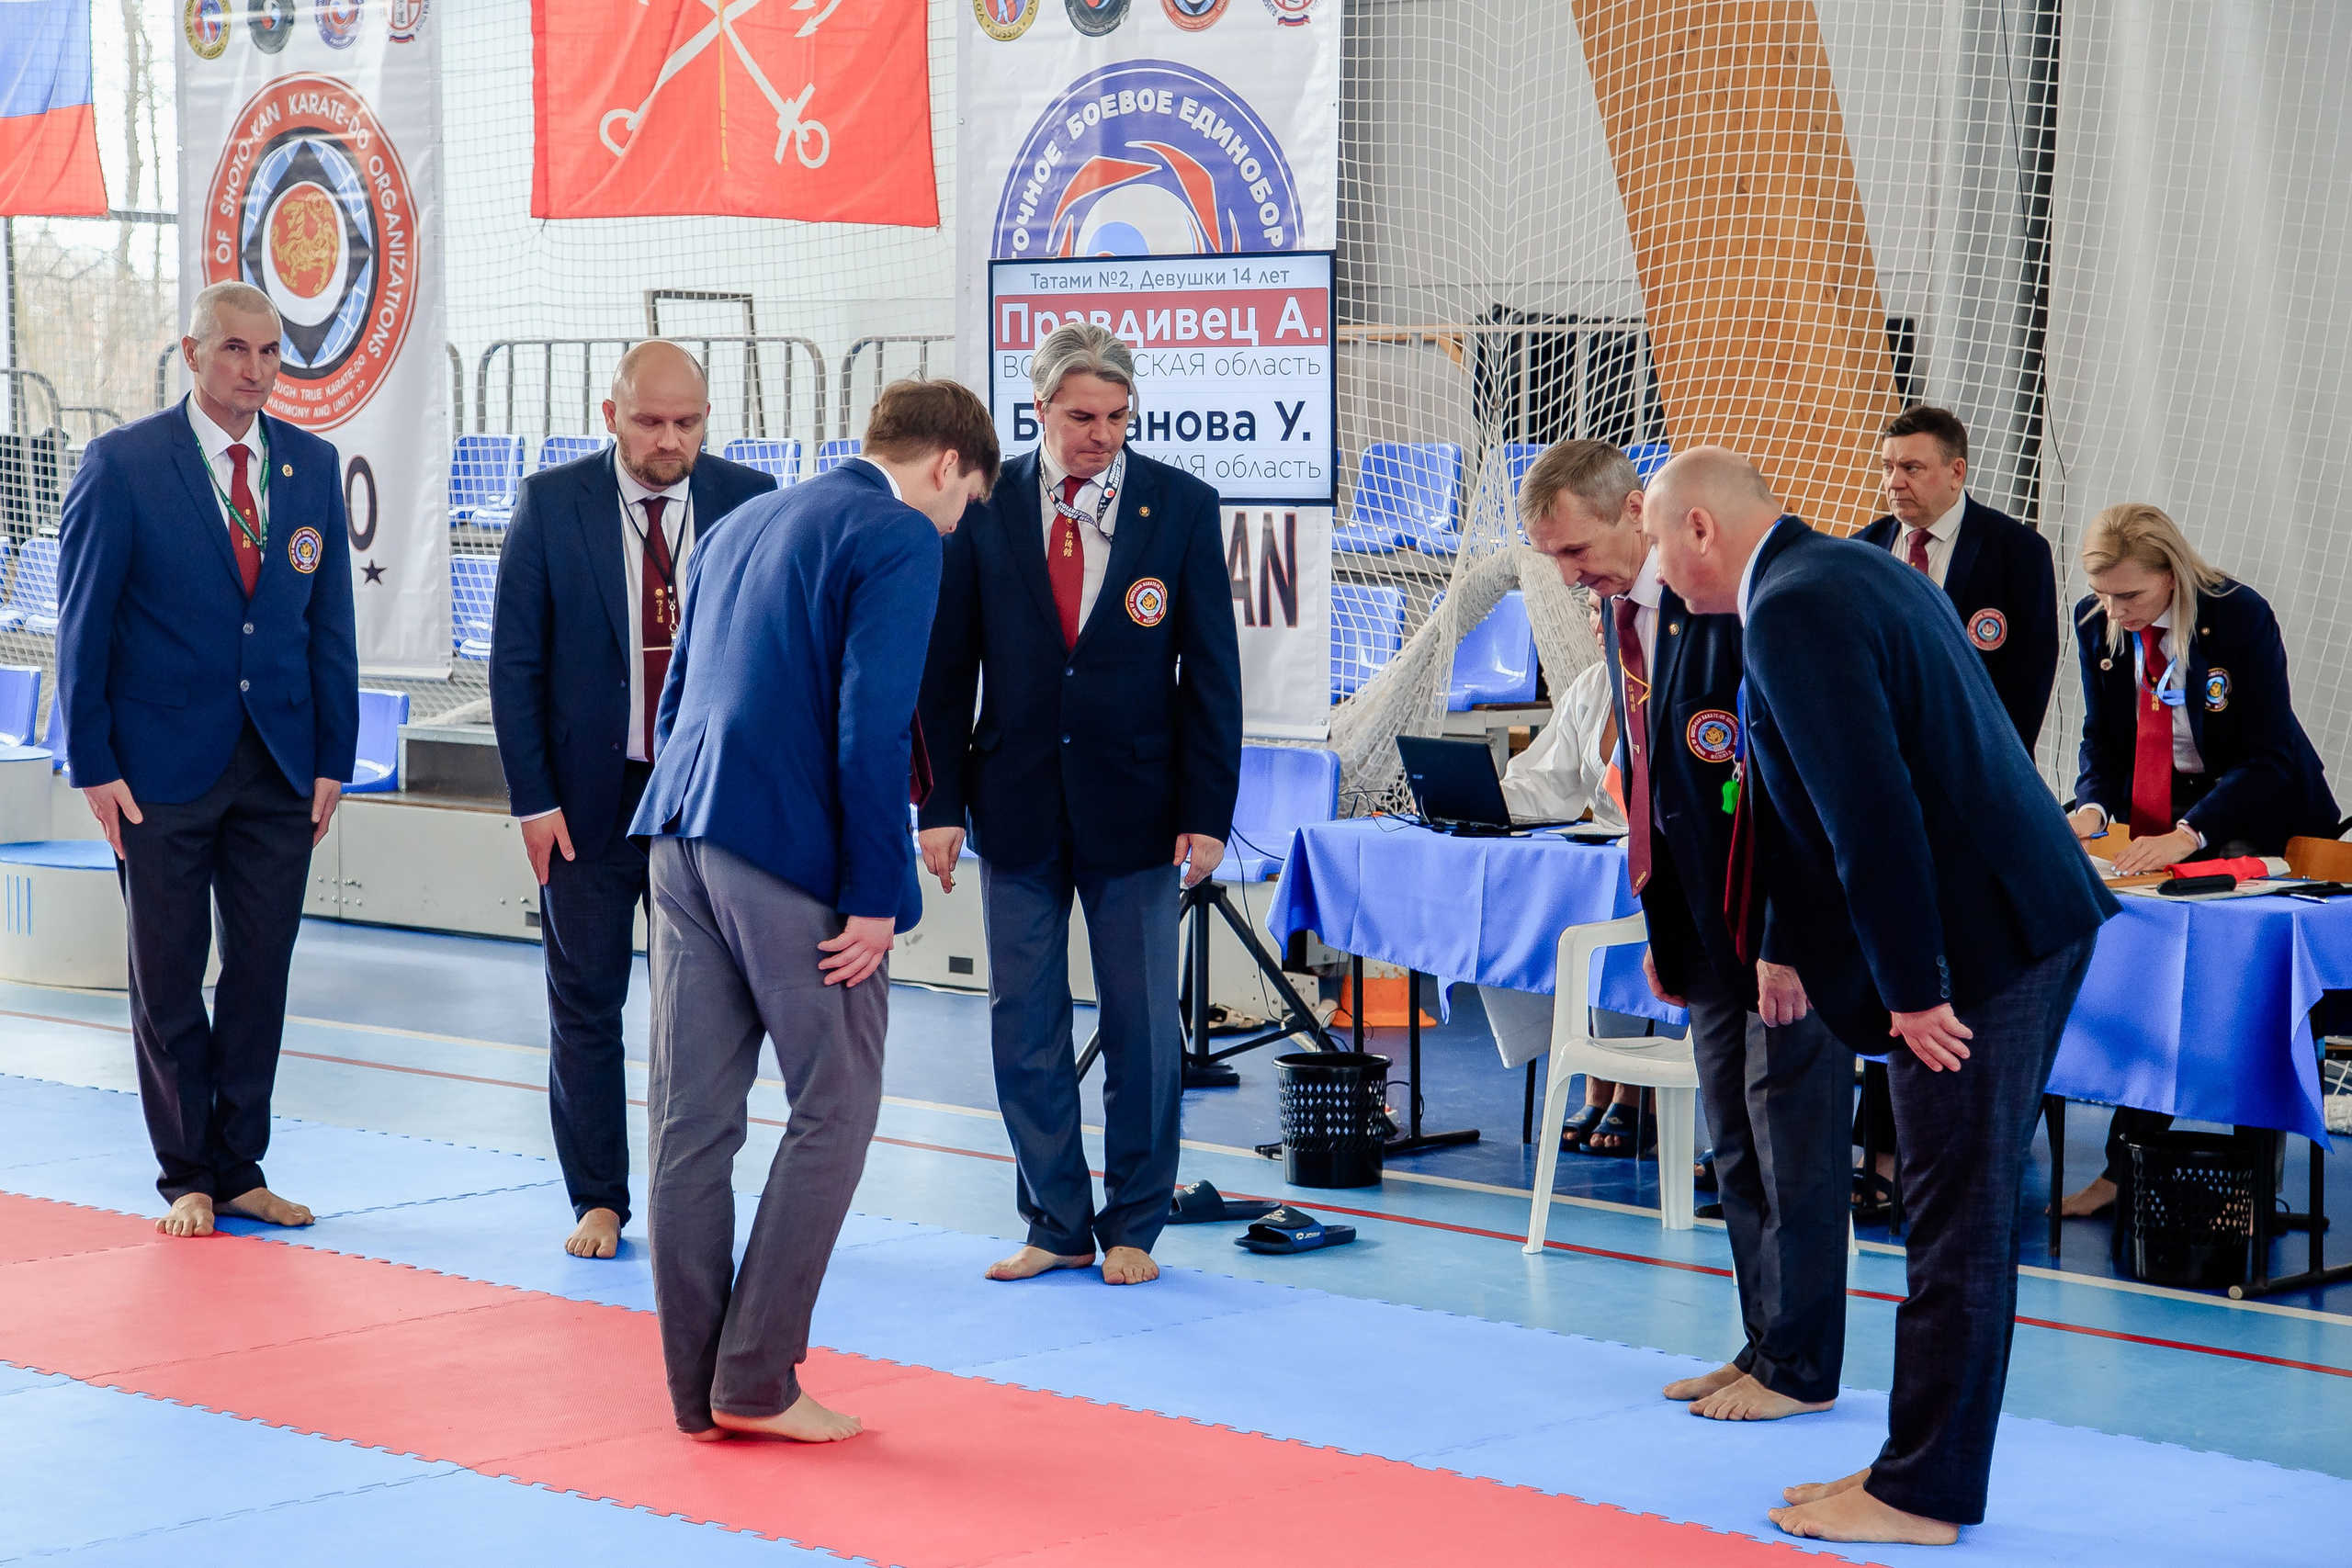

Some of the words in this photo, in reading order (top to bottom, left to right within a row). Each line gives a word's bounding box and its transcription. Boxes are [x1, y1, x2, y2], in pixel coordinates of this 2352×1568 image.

[288, 92, 369, 150] KARATE-DO
[220, 101, 281, 218] SHOTO-KAN
[1012, 141, 1062, 259] ОЧНОЕ
[1066, 88, 1173, 141] БОЕВОЕ
[1178, 96, 1284, 249] ЕДИНОБОР
[215, 230, 233, 264] OF
[368, 155, 406, 358] ORGANIZATIONS
[1030, 272, 1092, 289] Татами
[1098, 271, 1134, 289] №2,
[1139, 269, 1227, 290] Девушки
[1232, 267, 1251, 285] 14
[1259, 269, 1290, 285] лет
[1273, 295, 1323, 339] А.
[300, 388, 322, 401] TRUE
[325, 354, 367, 397] KARATE-DO
[1216, 352, 1321, 377] область
[266, 396, 311, 419] HARMONY
[313, 404, 331, 418] AND
[332, 388, 356, 412] UNITY
[1274, 400, 1311, 442] У.
[1216, 454, 1321, 479] область
